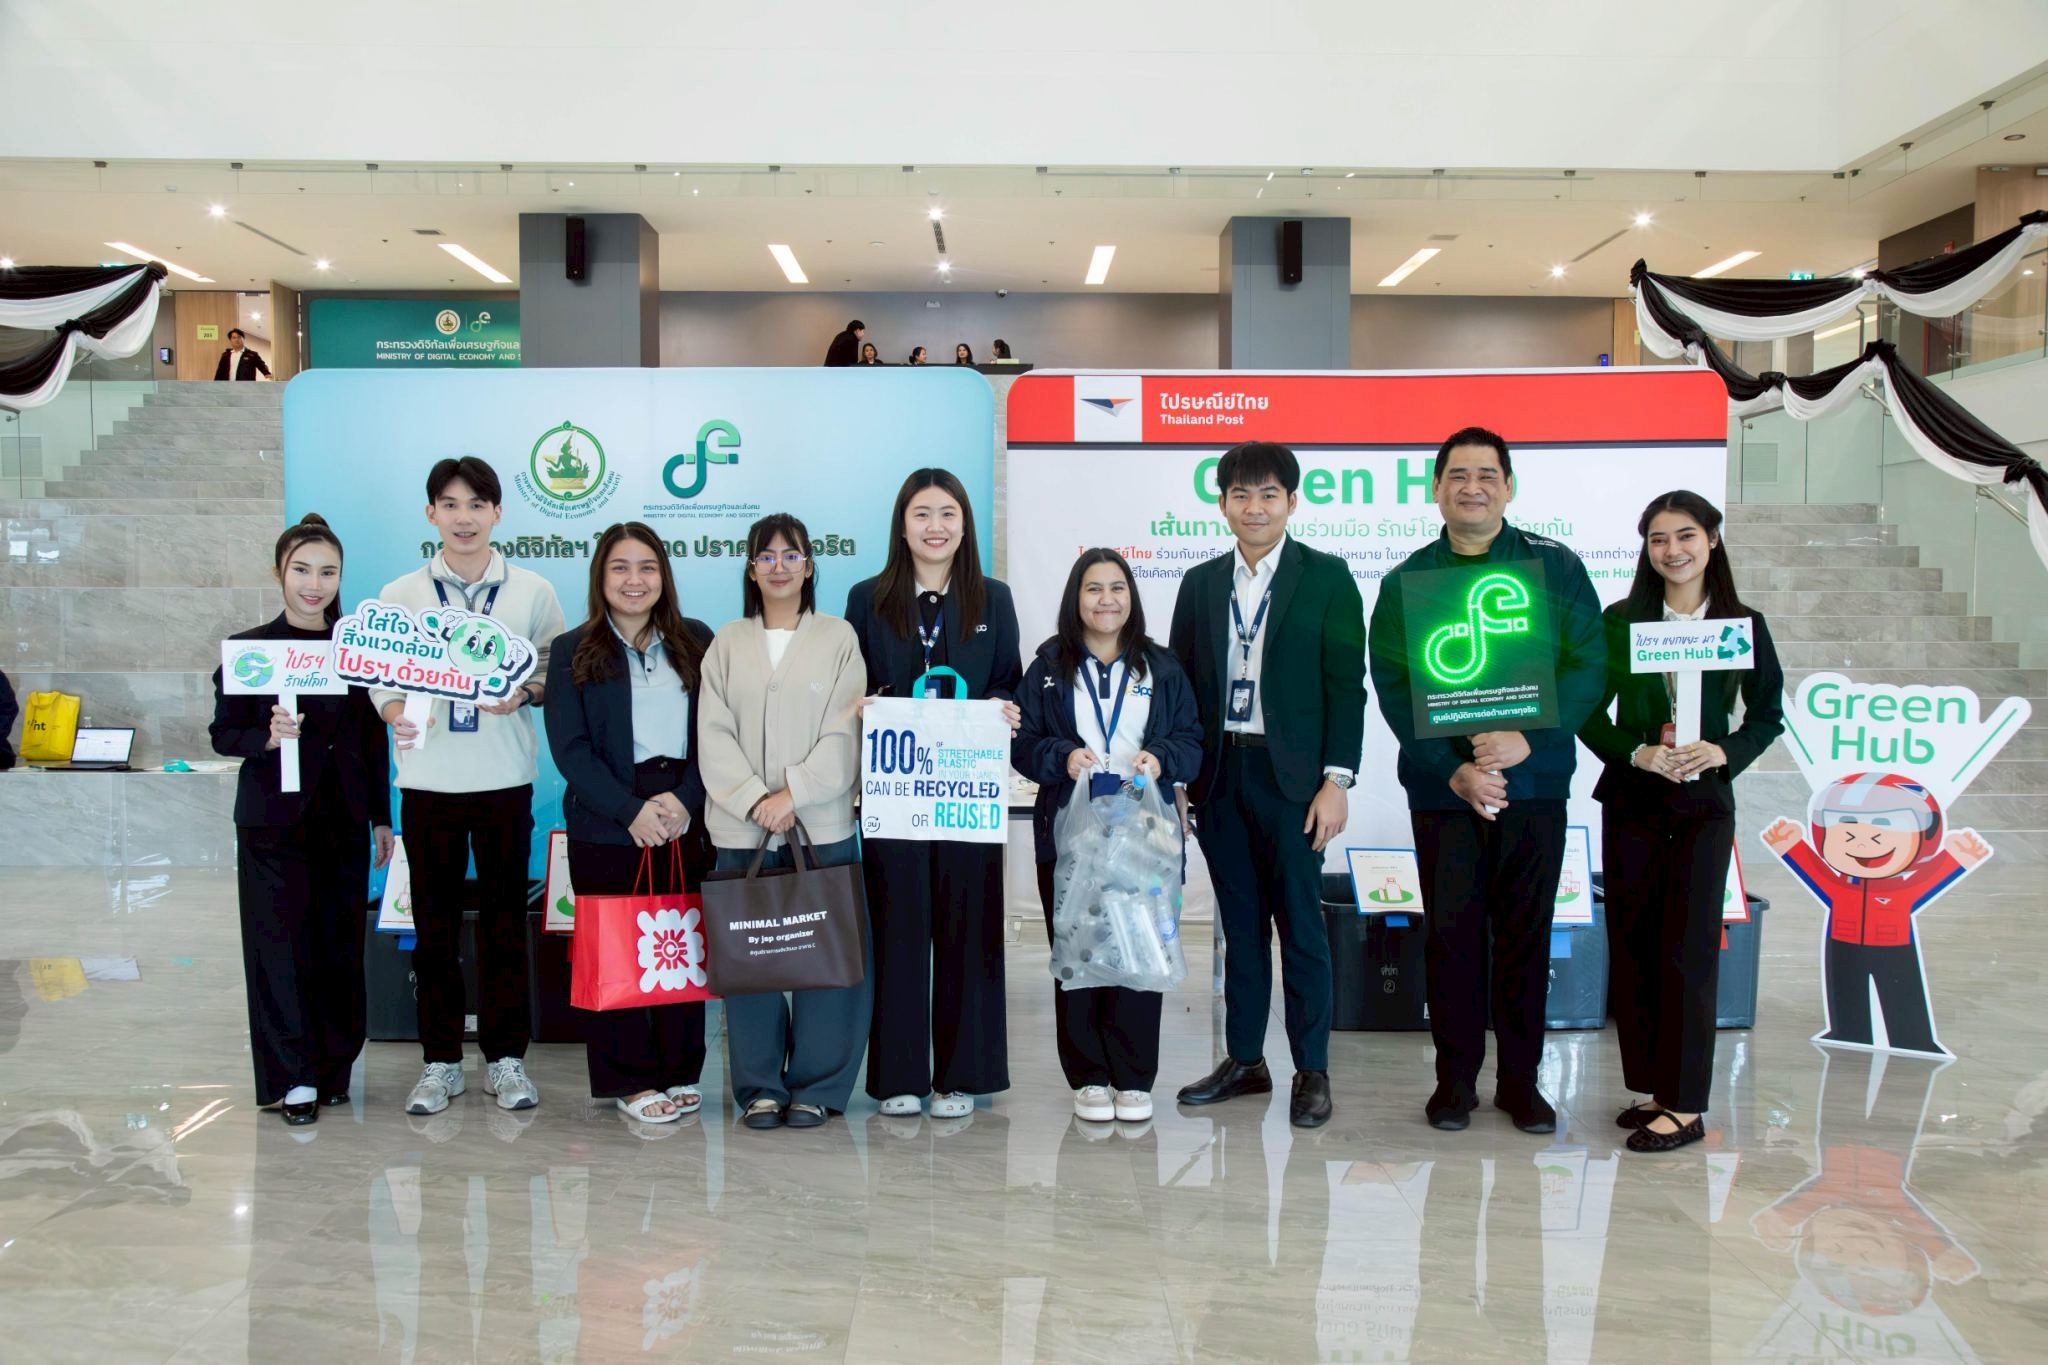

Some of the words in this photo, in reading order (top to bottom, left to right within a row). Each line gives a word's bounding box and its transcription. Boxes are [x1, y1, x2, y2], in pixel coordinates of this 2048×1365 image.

[1160, 392, 1269, 410] ไปรษณีย์ไทย
[1160, 414, 1213, 424] Thailand
[1217, 414, 1244, 424] Post
[1194, 457, 1374, 504] Gen
[539, 505, 563, 519] Digital
[565, 507, 597, 520] Economy
[598, 498, 609, 508] and
[1377, 516, 1440, 537] รักษ์โล
[367, 609, 411, 635] ใส่ใจ
[342, 623, 444, 660] สิ่งแวดล้อม
[285, 647, 326, 669] ไปรฯ
[1637, 649, 1680, 661] Green
[1685, 647, 1713, 659] Hub
[284, 671, 328, 688] รักษ์โลก
[339, 647, 391, 677] ไปรฯ
[396, 660, 472, 691] ด้วยกัน
[1807, 682, 1967, 724] Green
[867, 728, 933, 775] 100%
[938, 749, 1003, 760] STRETCHABLE
[1831, 725, 1935, 765] Hub
[938, 759, 976, 769] PLASTIC
[865, 780, 890, 796] CAN
[895, 782, 910, 797] BE
[914, 780, 1000, 798] RECYCLED
[912, 814, 929, 827] OR
[934, 801, 1001, 830] REUSED
[729, 919, 780, 931] MINIMAL
[783, 910, 828, 926] MARKET
[748, 936, 759, 944] By
[776, 930, 815, 942] organizer
